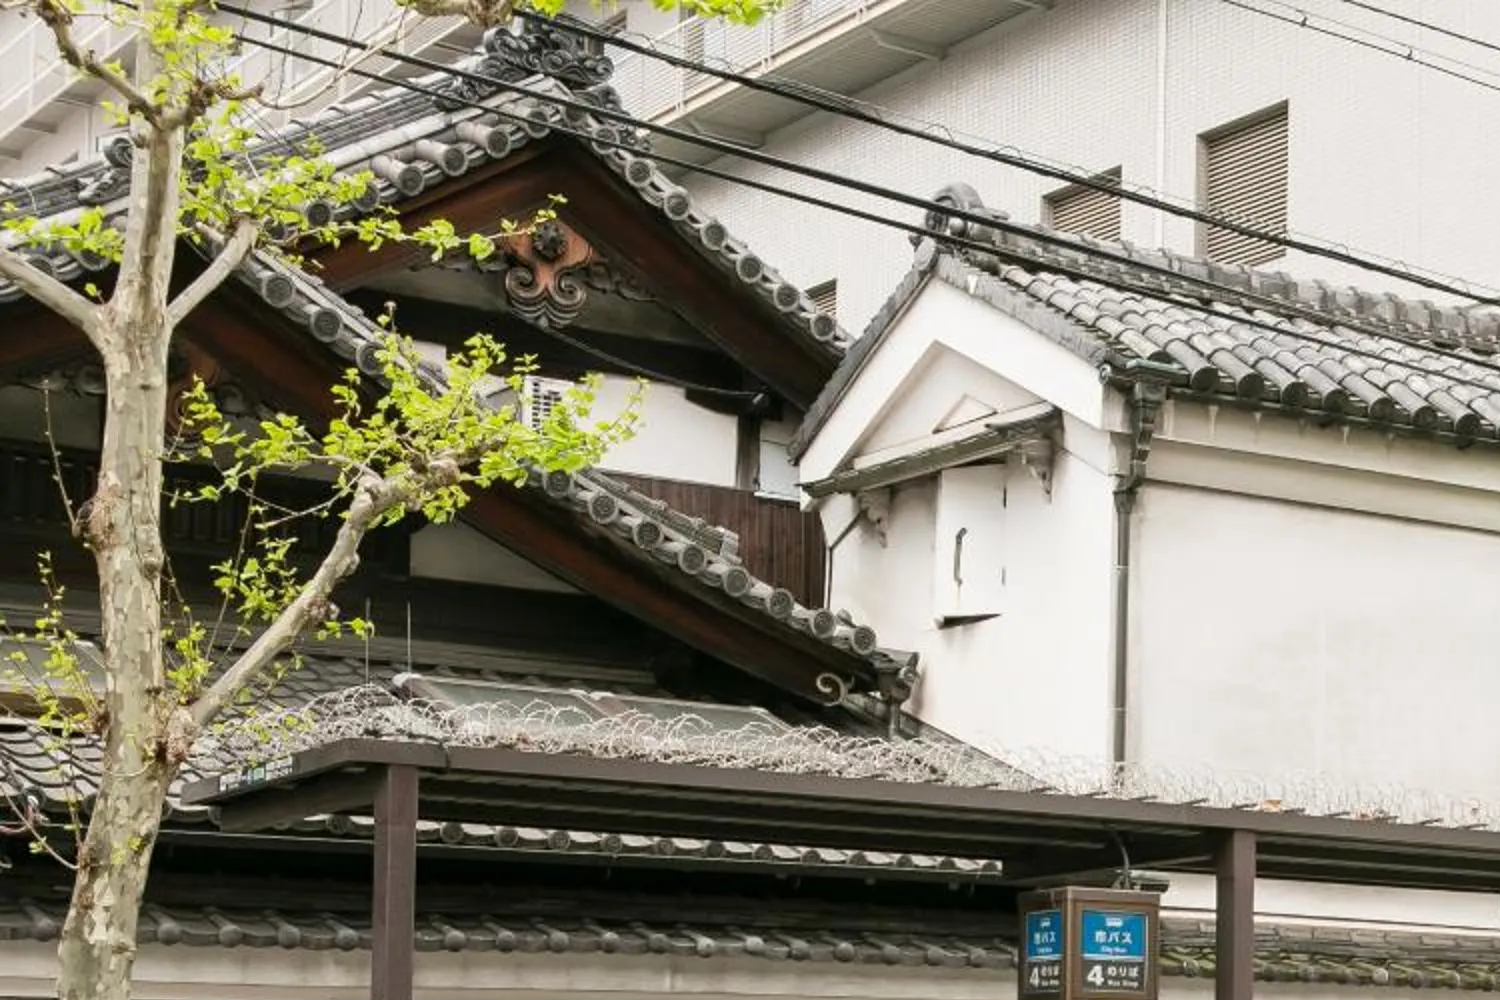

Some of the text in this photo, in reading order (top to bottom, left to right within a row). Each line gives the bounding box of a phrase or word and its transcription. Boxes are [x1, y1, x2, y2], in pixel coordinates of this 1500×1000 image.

[1095, 930, 1133, 945] 市バス
[1029, 967, 1040, 988] 4
[1087, 964, 1105, 987] 4
[1107, 965, 1139, 977] のりば
